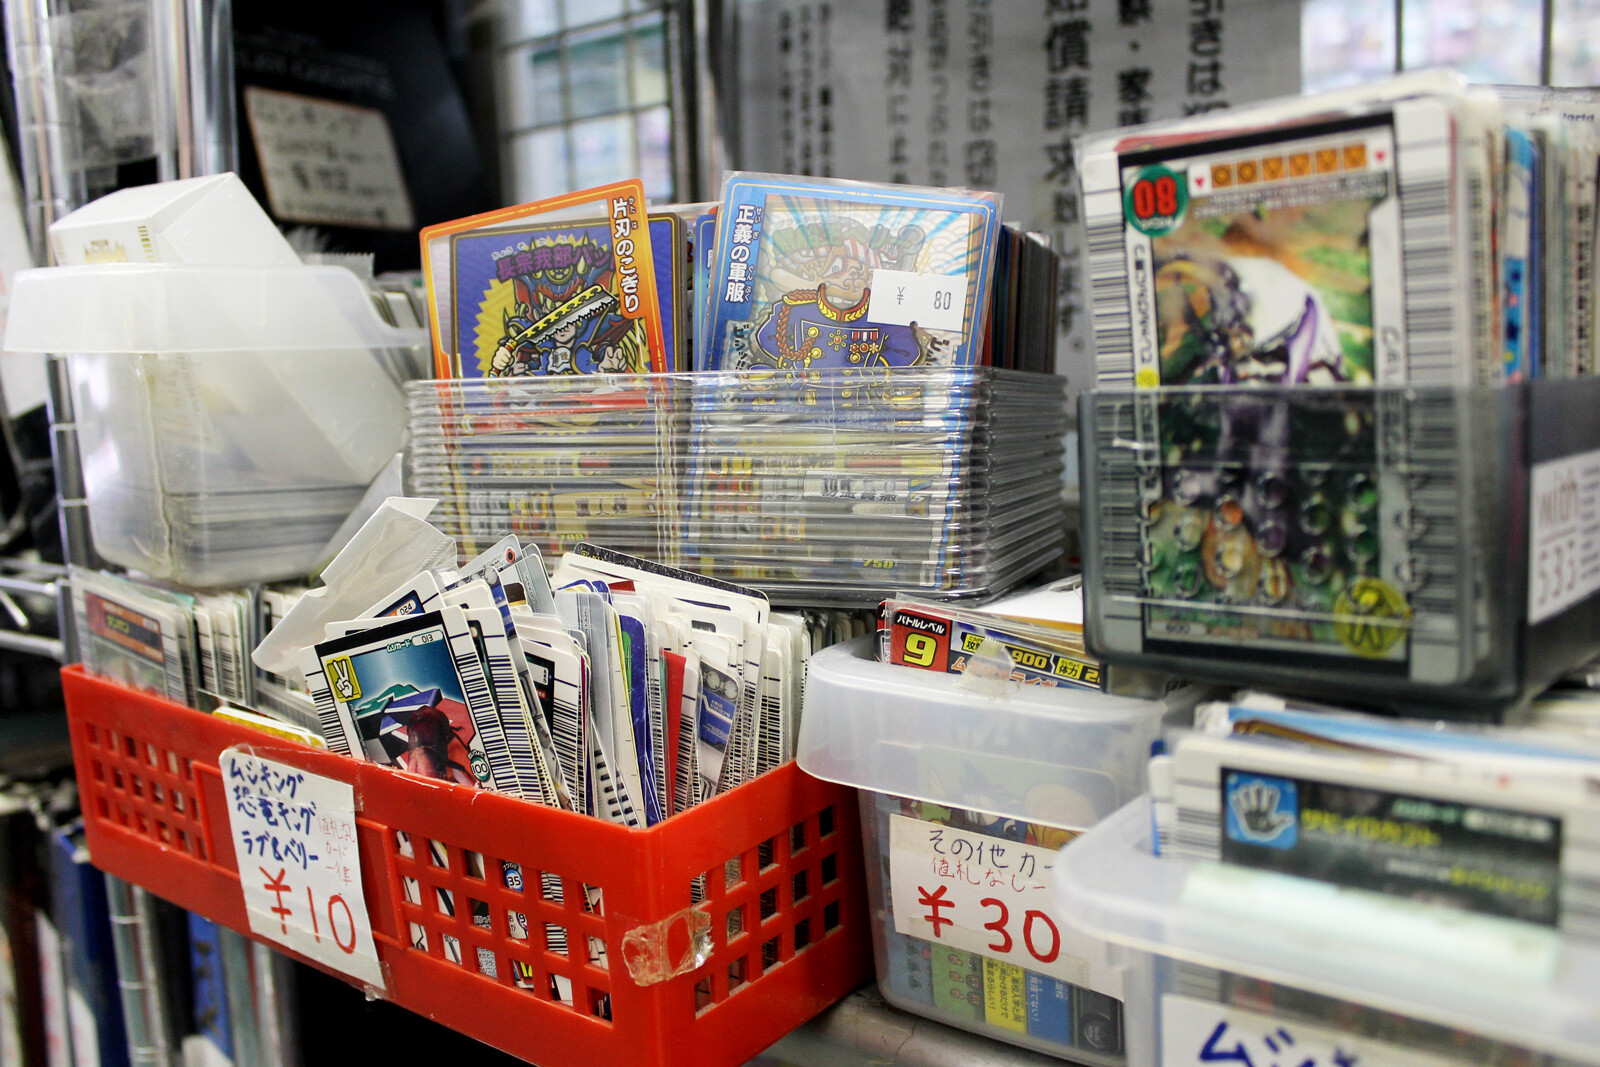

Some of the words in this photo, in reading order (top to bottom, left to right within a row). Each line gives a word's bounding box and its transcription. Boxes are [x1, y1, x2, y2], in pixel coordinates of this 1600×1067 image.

[1132, 175, 1178, 219] 08
[497, 244, 614, 283] 長宗我部バッ
[611, 197, 640, 313] 片刃のこぎり
[725, 204, 756, 303] 正義の軍服
[896, 286, 906, 306] ¥
[933, 290, 952, 310] 80
[399, 603, 413, 616] 024
[897, 615, 945, 634] バトルレベル
[421, 633, 434, 644] 013
[903, 633, 938, 667] 9
[1059, 665, 1079, 677] 体力
[1085, 669, 1100, 682] 2
[507, 875, 522, 887] 35
